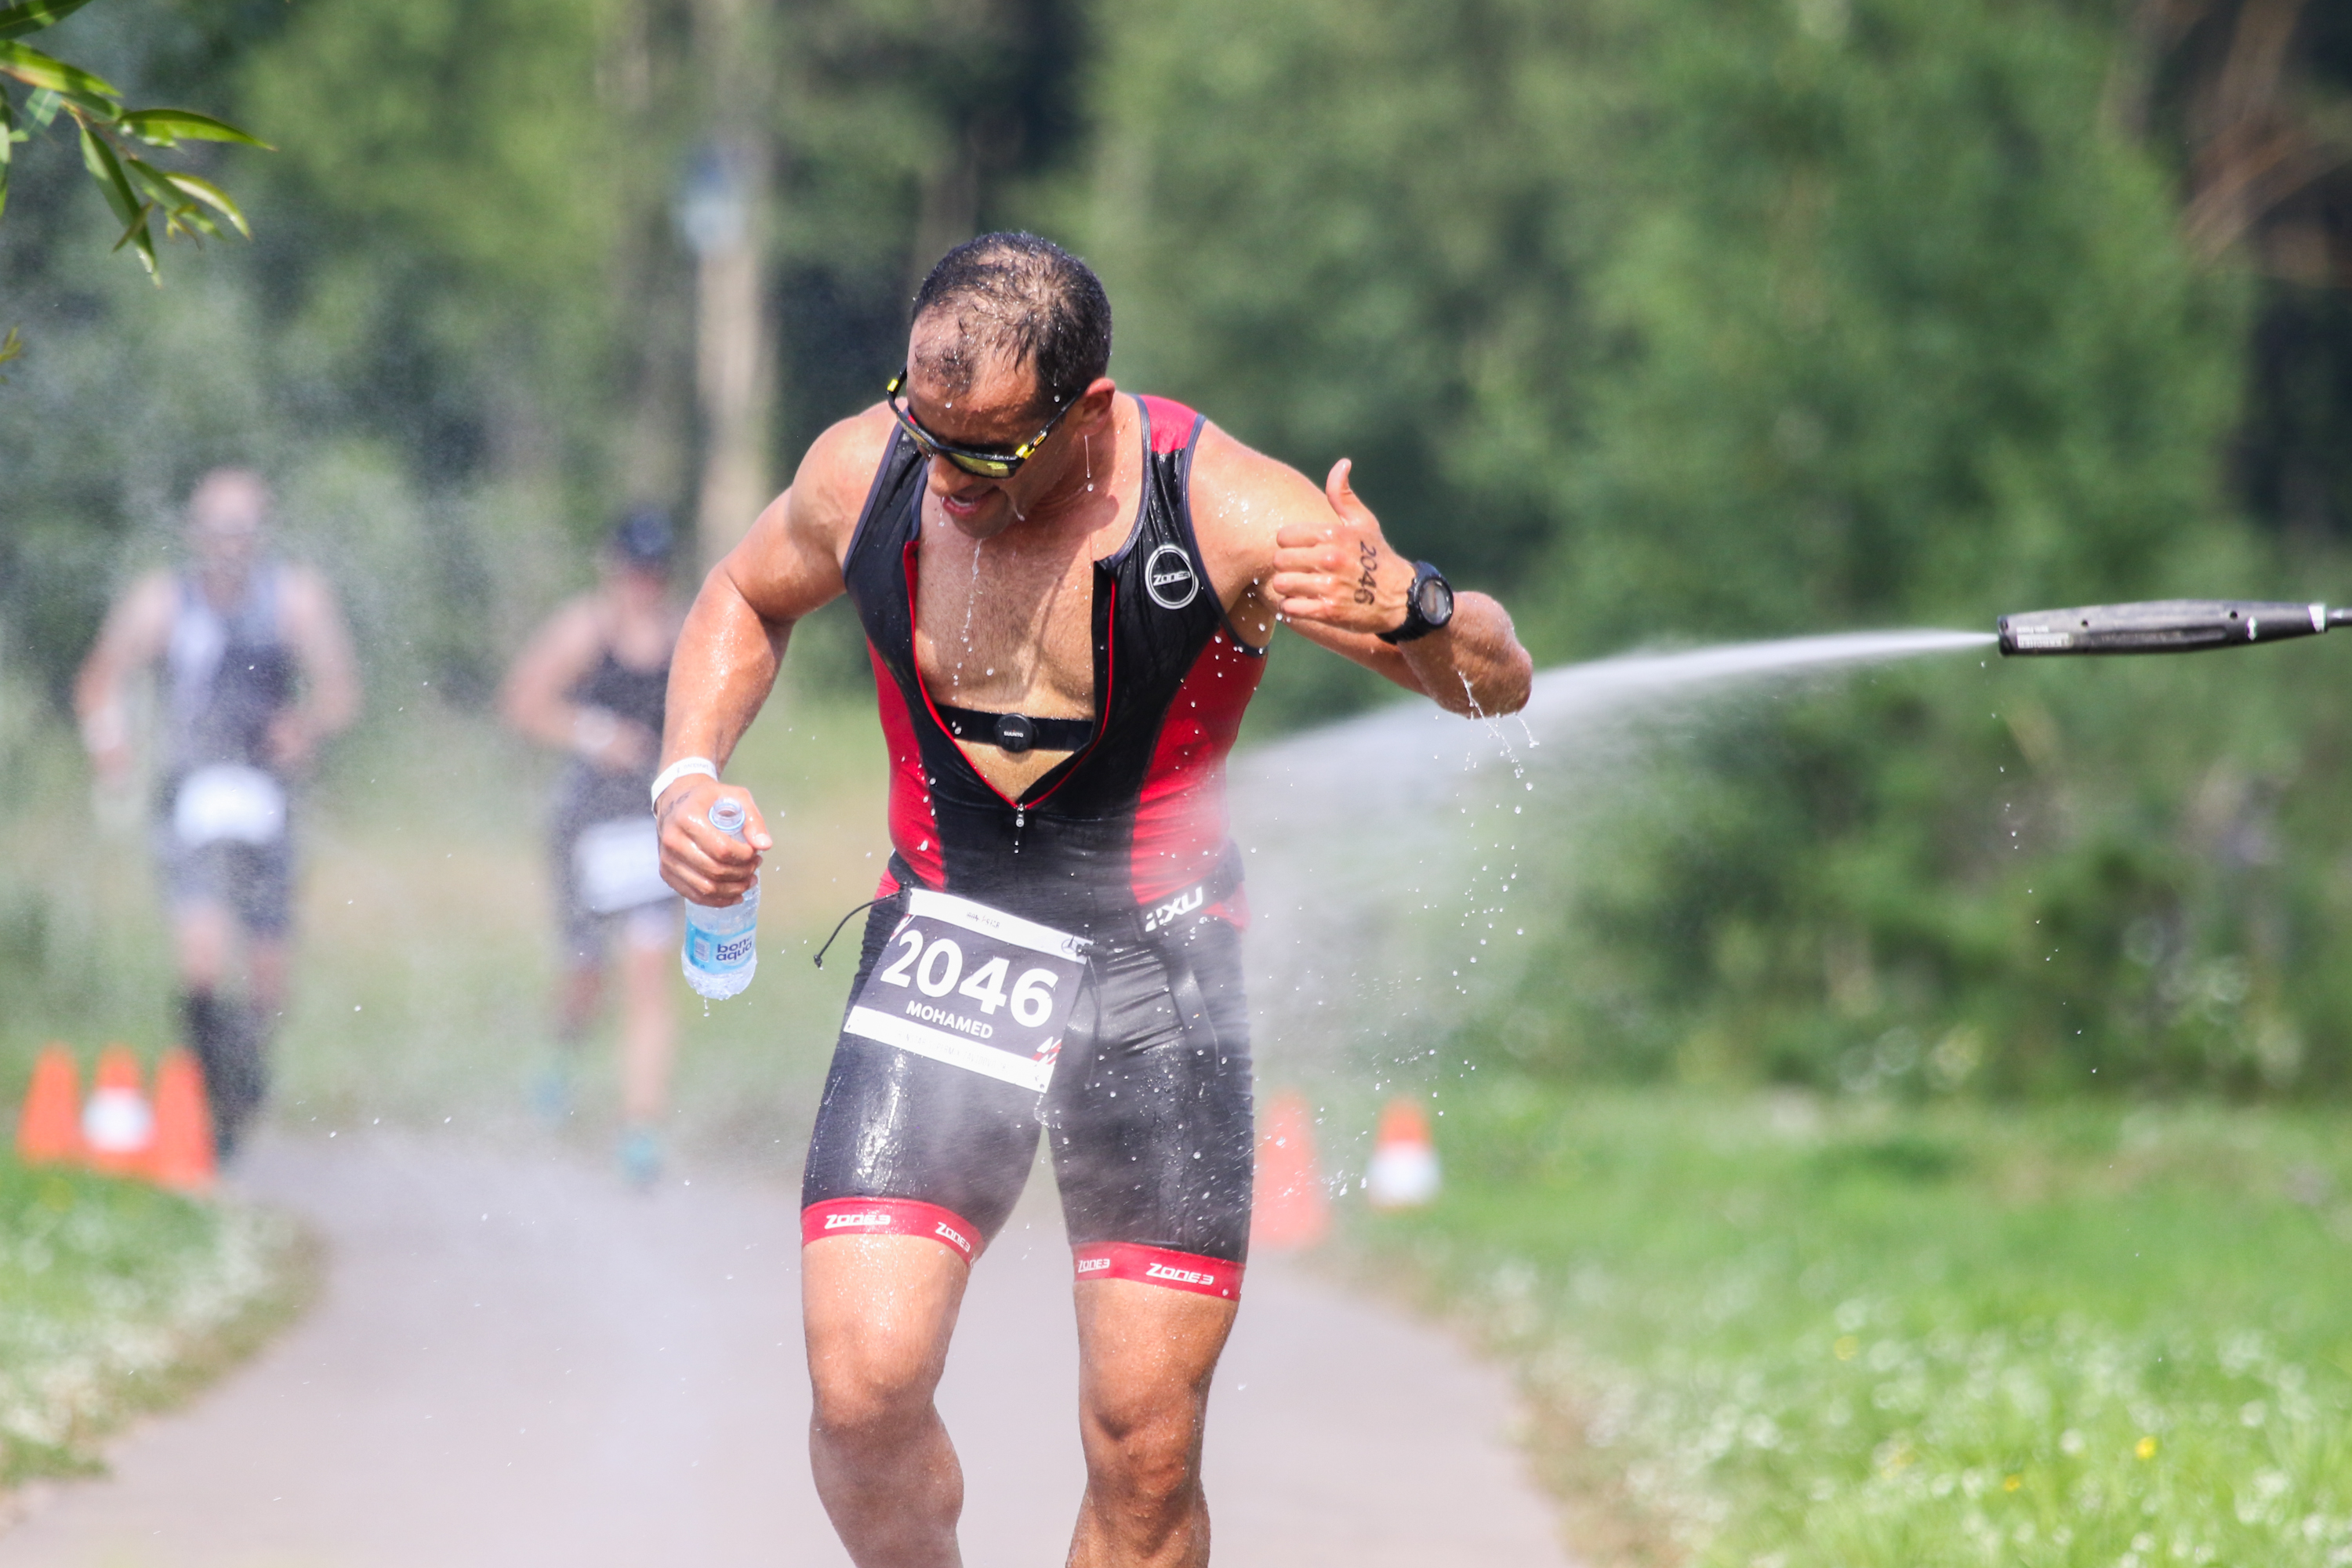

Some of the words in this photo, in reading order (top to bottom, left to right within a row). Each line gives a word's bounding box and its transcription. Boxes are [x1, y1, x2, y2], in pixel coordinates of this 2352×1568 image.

[1354, 540, 1377, 605] 2046
[716, 940, 753, 961] aqua
[880, 929, 1059, 1028] 2046
[906, 1000, 993, 1040] MOHAMED
[824, 1214, 891, 1230] ZONE3
[935, 1221, 971, 1254] ZONE3
[1078, 1258, 1111, 1274] ZONE3
[1145, 1254, 1214, 1286] ZONE3
